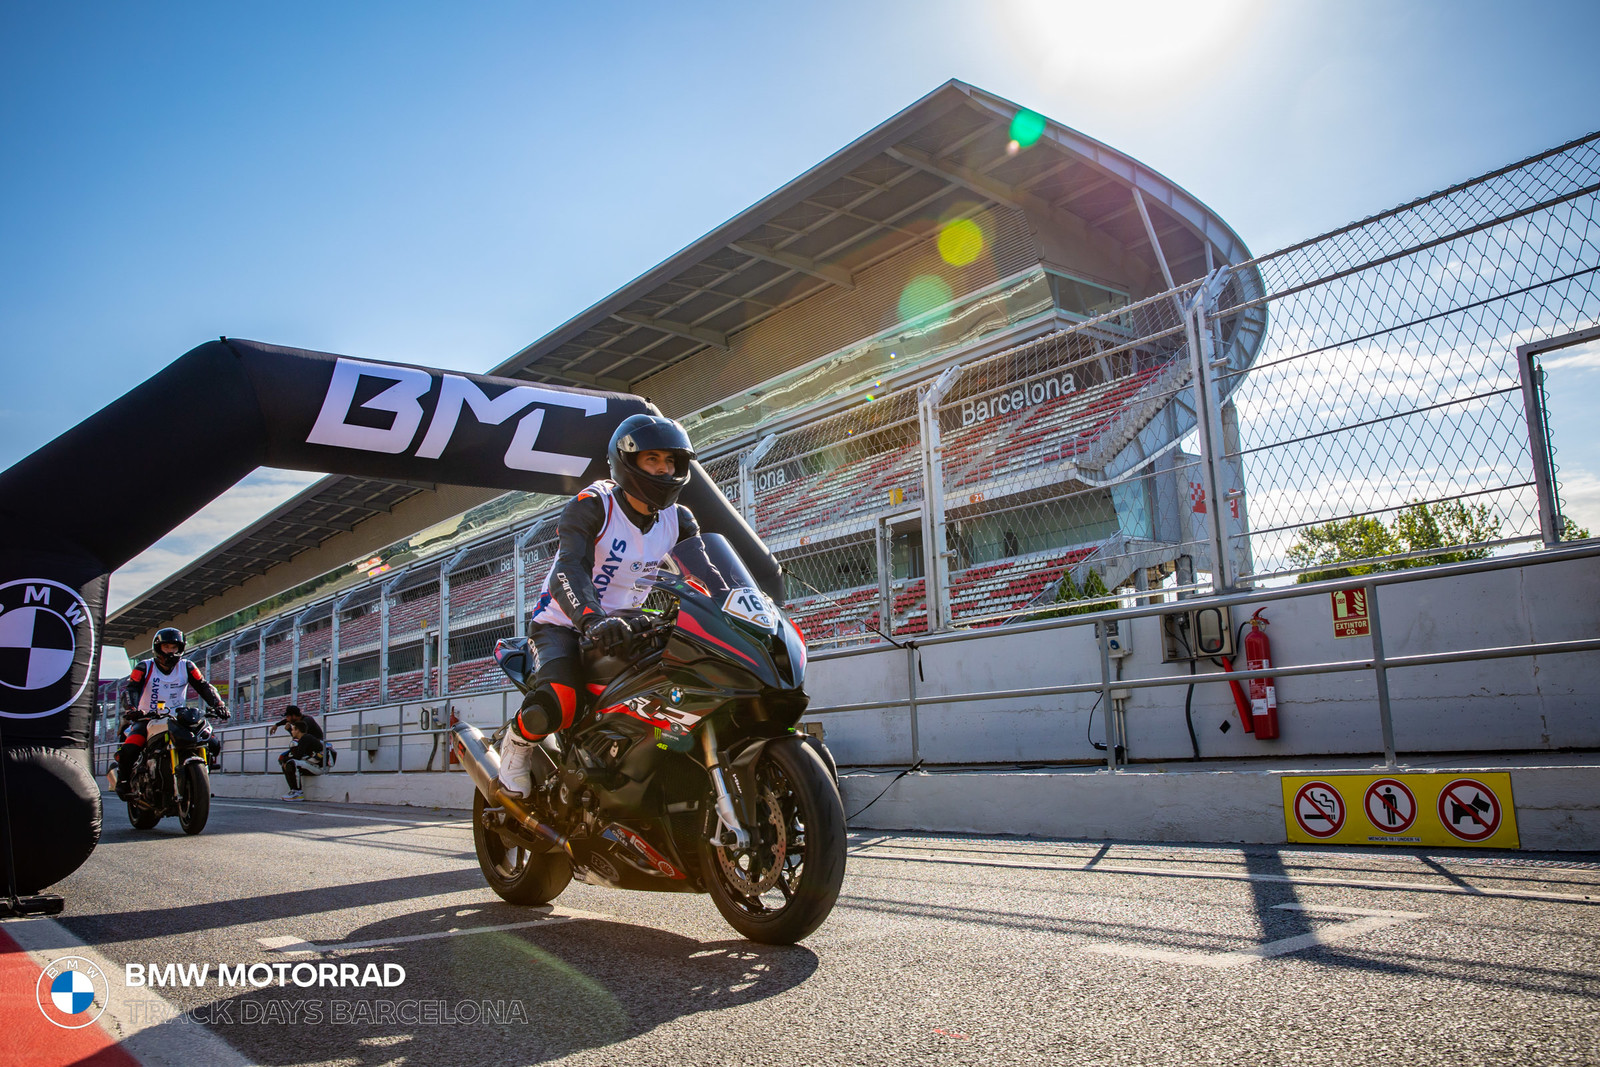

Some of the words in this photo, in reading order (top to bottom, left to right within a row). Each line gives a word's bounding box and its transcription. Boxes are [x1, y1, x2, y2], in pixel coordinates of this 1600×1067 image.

[305, 357, 608, 478] BMC
[961, 373, 1077, 426] Barcelona
[0, 585, 87, 627] MW
[1336, 621, 1367, 630] EXTINTOR
